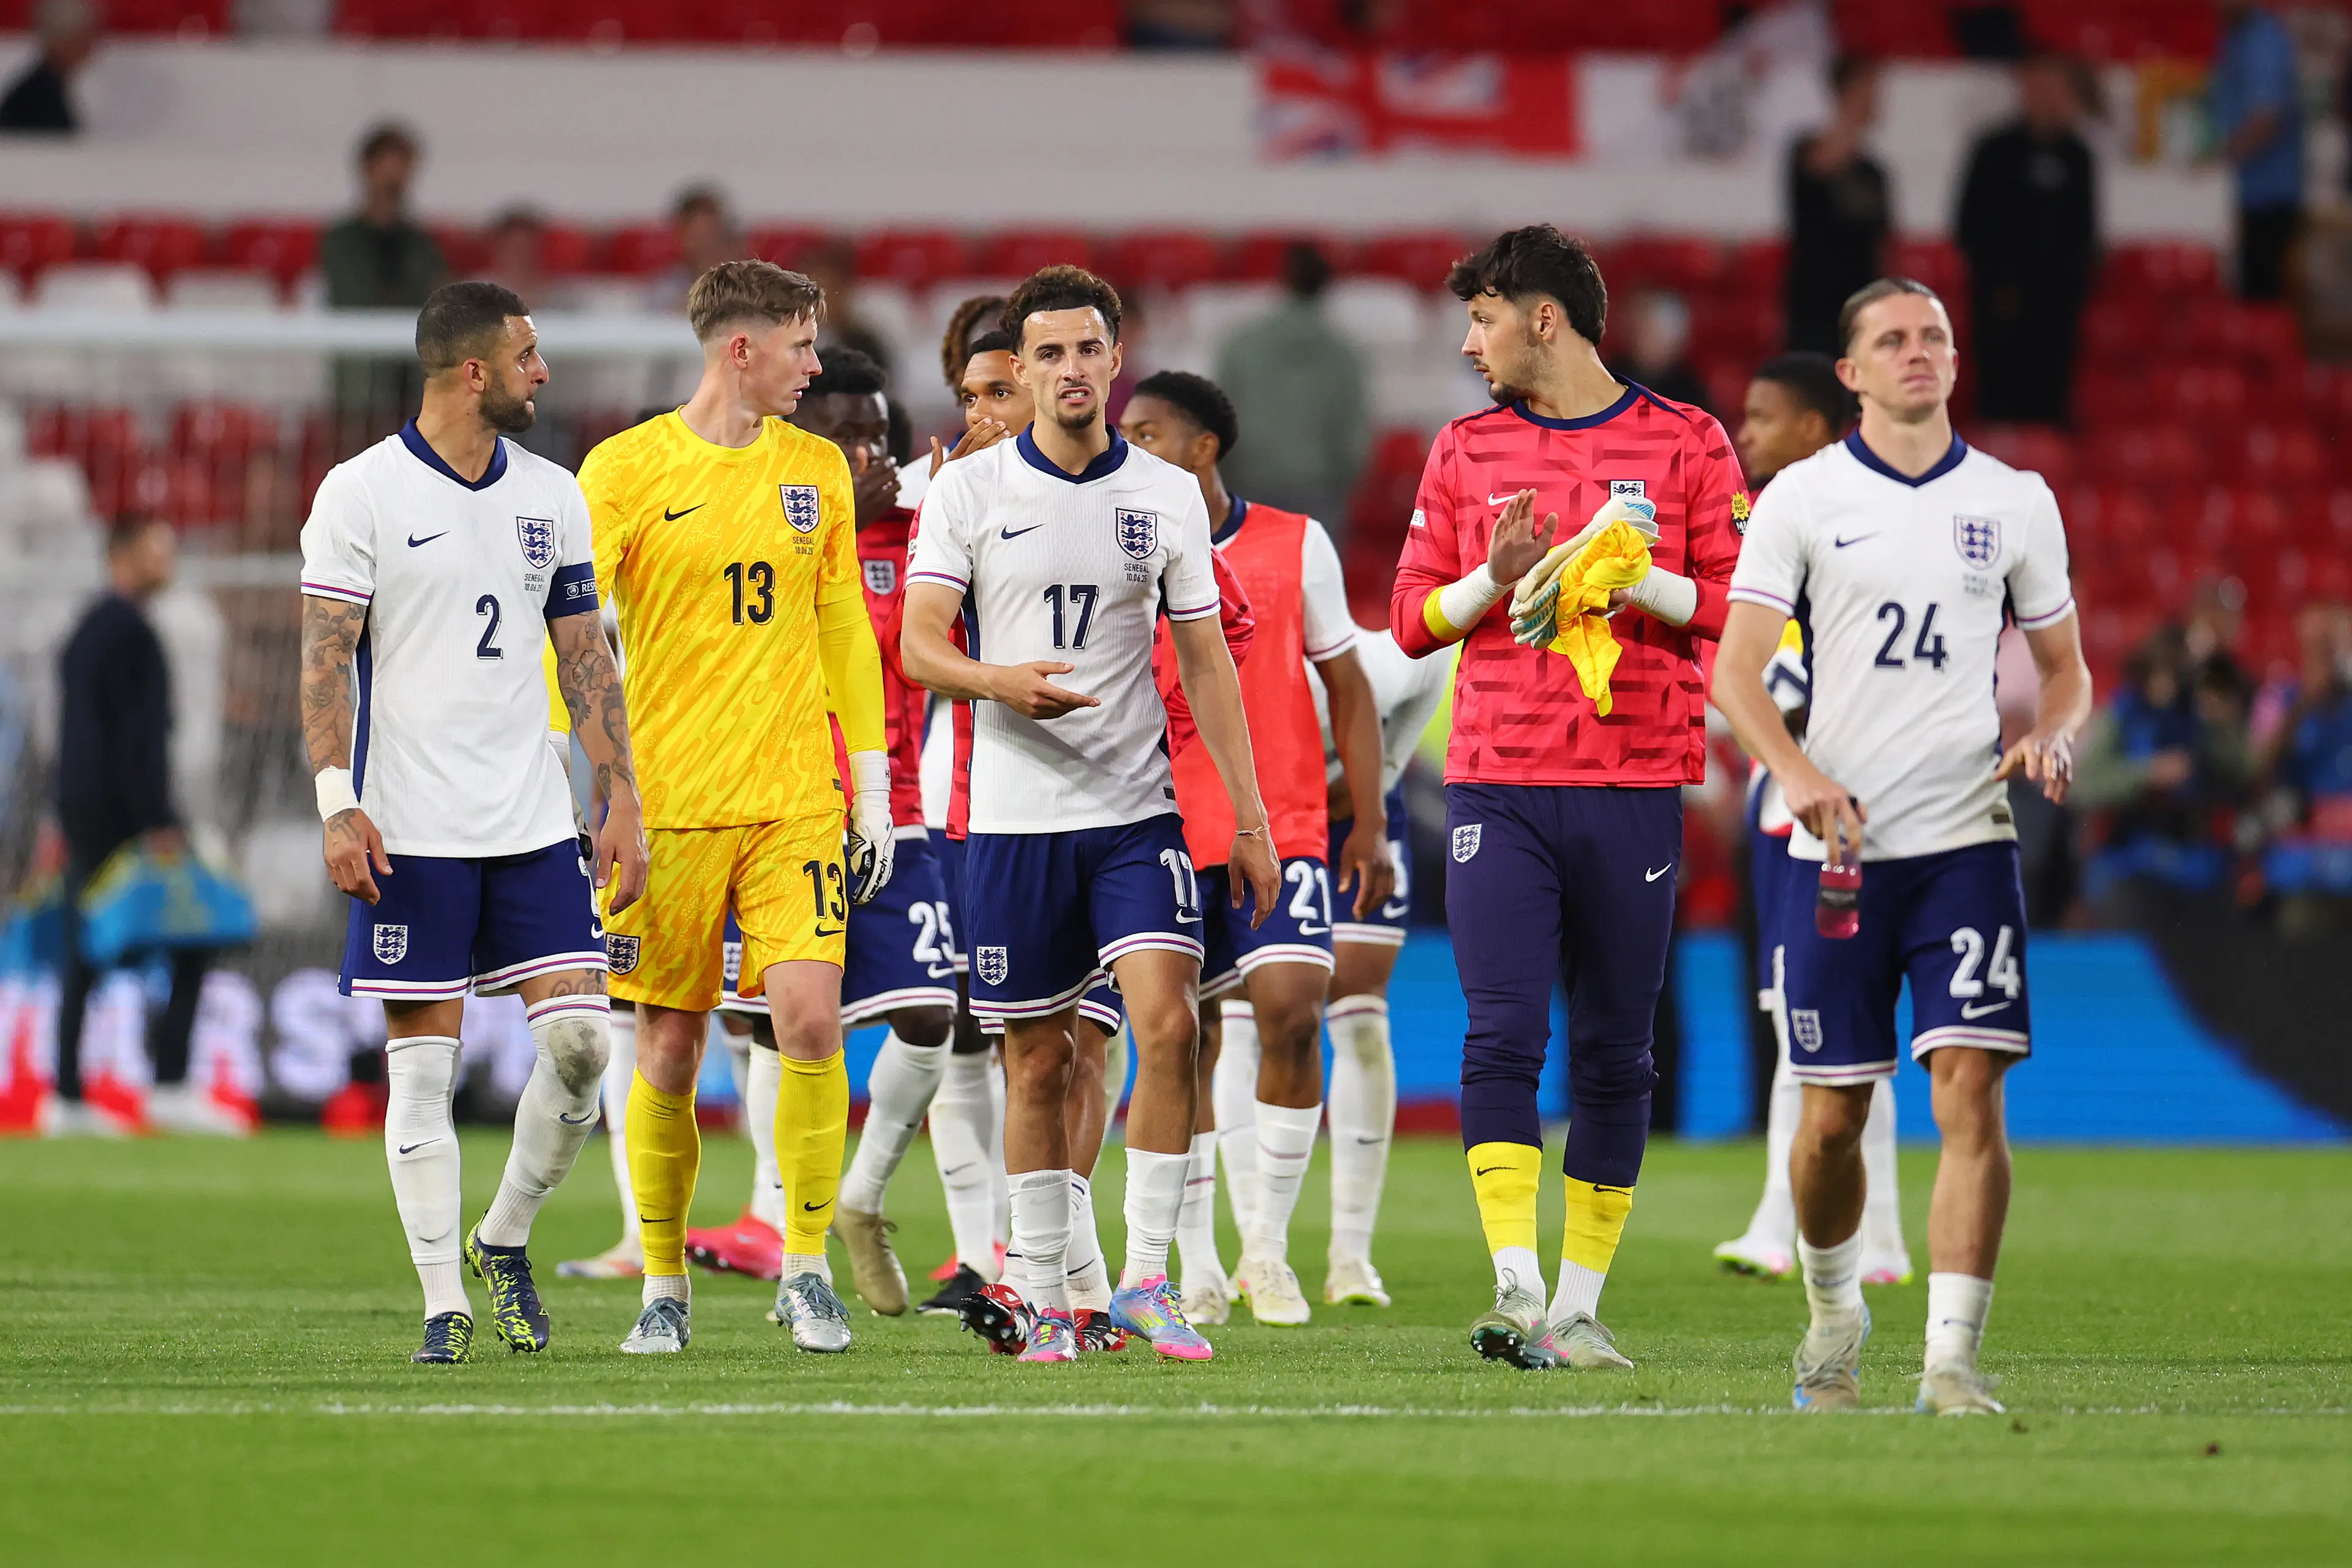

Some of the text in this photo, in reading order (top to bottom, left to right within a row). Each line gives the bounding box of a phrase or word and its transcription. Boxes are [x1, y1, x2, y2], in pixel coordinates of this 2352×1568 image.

[793, 536, 815, 545] SENEGAL
[795, 546, 813, 555] 10.06.25
[1124, 563, 1149, 573] SENEGAL
[524, 573, 545, 582] SENEGAL
[723, 561, 776, 626] 13
[1126, 573, 1147, 582] 10.06.25
[476, 594, 504, 660] 2
[1044, 584, 1099, 650] 17
[1875, 602, 1949, 673] 24
[802, 860, 846, 925] 13
[1284, 860, 1332, 928] 21
[908, 900, 956, 963] 25
[1949, 924, 2021, 1000] 24
